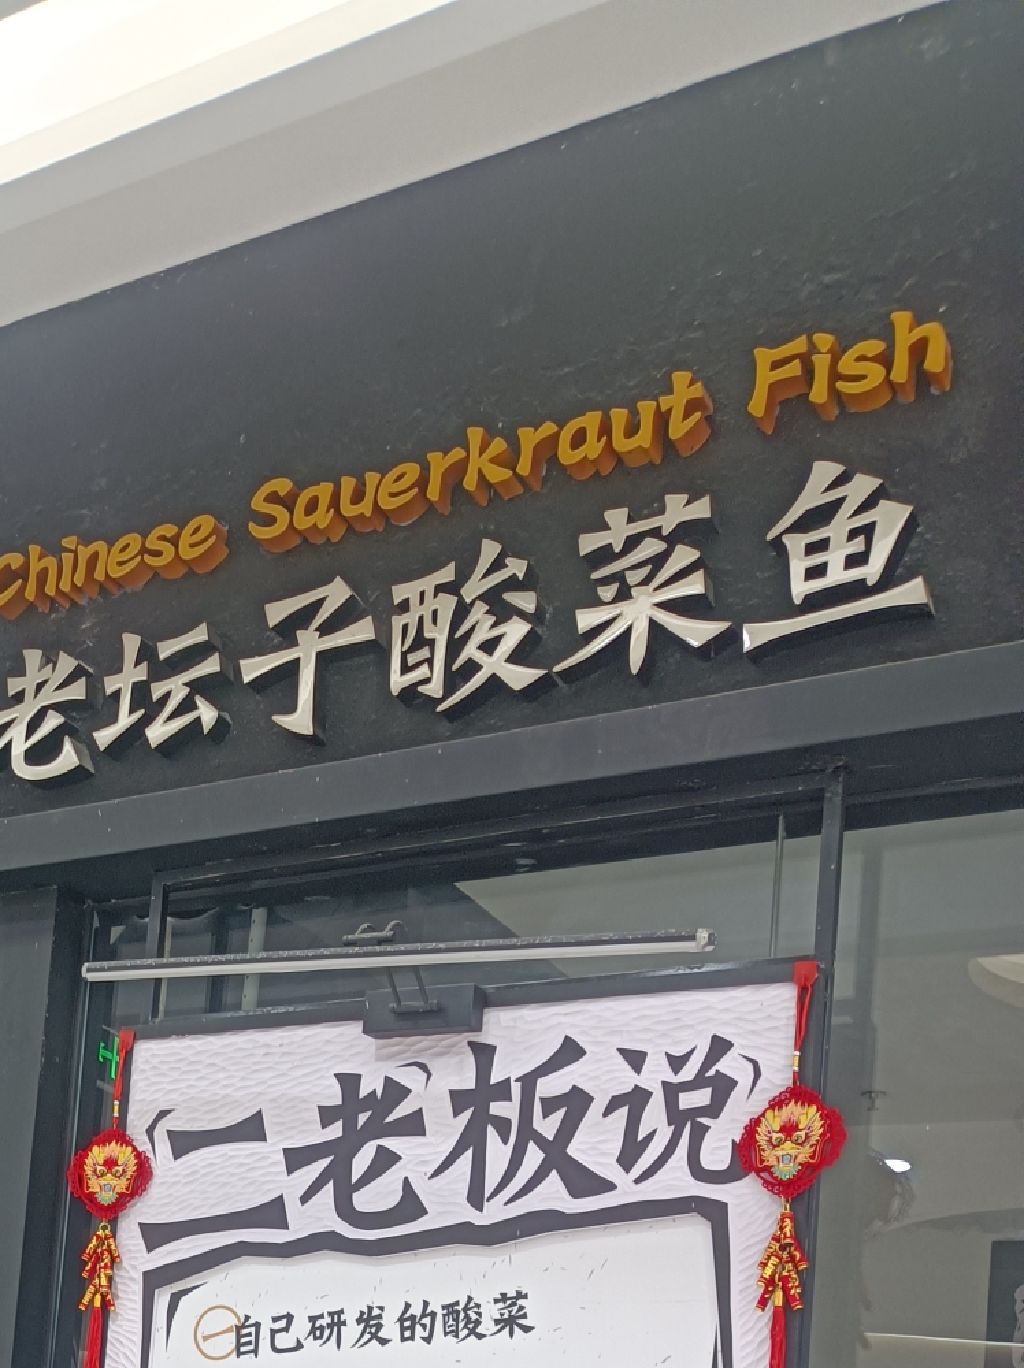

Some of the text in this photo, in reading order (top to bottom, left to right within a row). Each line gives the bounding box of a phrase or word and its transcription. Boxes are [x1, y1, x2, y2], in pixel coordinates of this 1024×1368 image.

[249, 371, 710, 547] Sauerkraut
[748, 311, 950, 430] Fish
[139, 1034, 752, 1253] 二老板说
